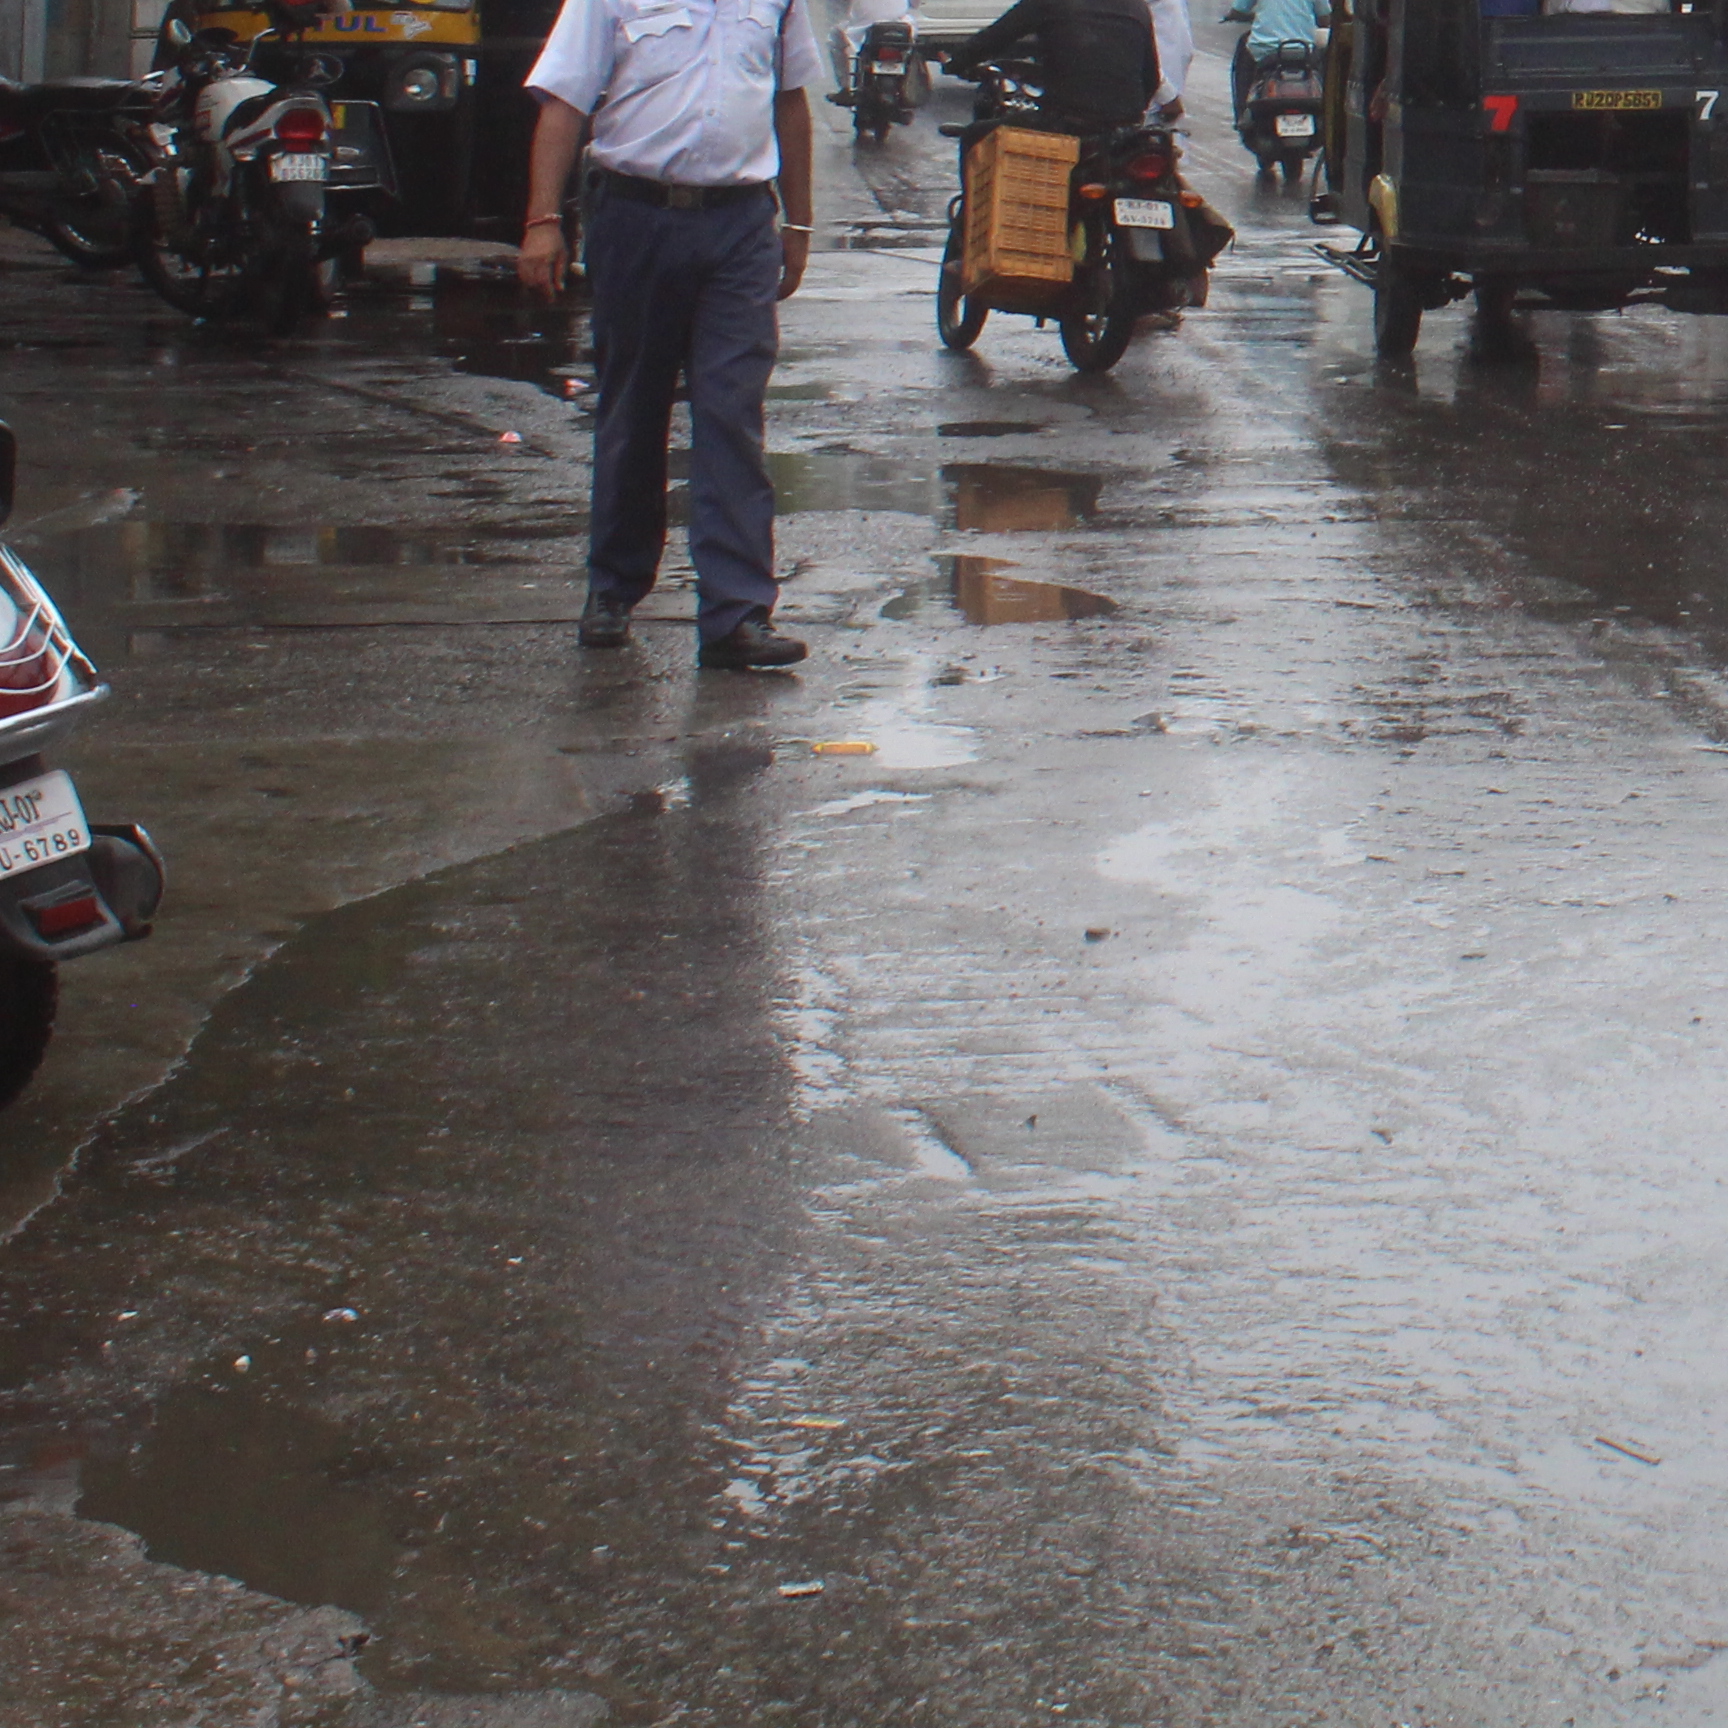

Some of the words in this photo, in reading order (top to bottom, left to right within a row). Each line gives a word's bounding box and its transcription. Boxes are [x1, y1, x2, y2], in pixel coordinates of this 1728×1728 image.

[313, 13, 387, 33] TUL
[1483, 95, 1518, 131] 7
[1696, 90, 1719, 120] 7
